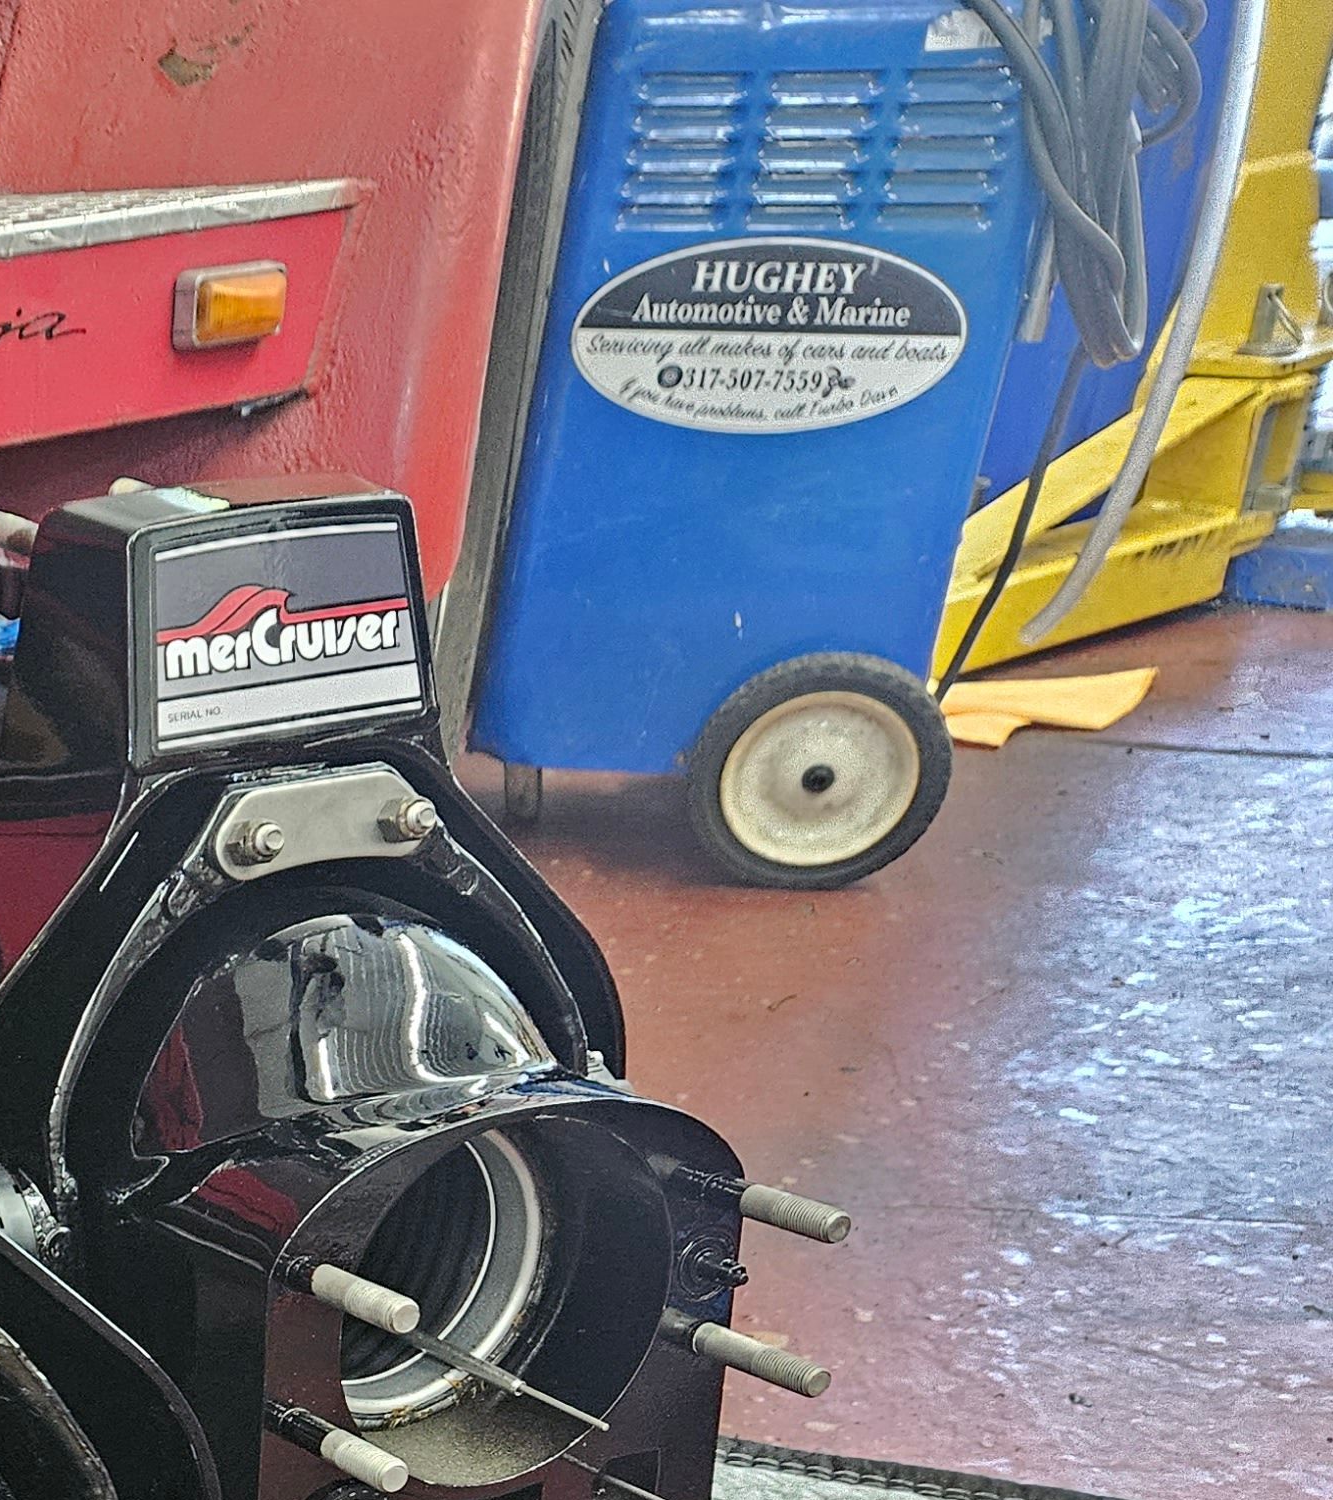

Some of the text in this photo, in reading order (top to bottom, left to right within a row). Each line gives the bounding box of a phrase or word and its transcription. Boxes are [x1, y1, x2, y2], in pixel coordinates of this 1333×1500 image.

[691, 260, 867, 295] HUGHEY
[632, 292, 912, 328] Automotive & Marine
[586, 333, 948, 365] Servicing all makes of cars and boats
[683, 366, 823, 393] 317-507-7559
[167, 709, 202, 724] SERIAL
